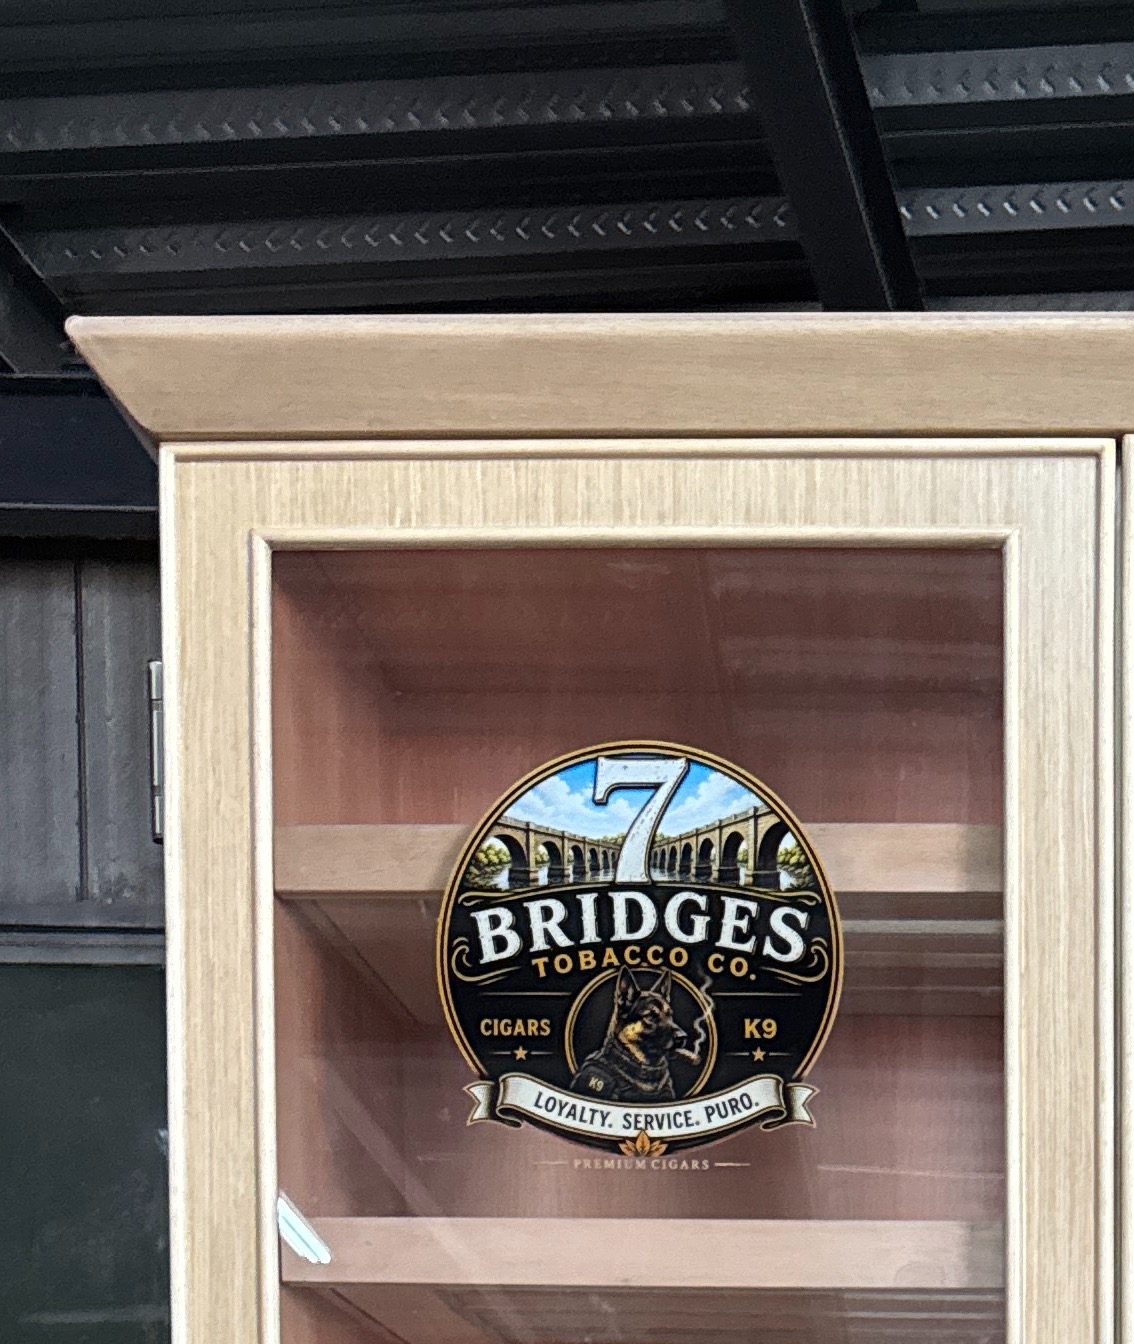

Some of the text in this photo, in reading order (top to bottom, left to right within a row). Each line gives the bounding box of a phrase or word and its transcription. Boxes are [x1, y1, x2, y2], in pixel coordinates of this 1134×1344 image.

[593, 756, 690, 884] 7
[470, 891, 811, 965] BRIDGES
[531, 945, 757, 981] TOBACCO CO.
[480, 1018, 551, 1037] CIGARS
[744, 1018, 778, 1039] K9
[588, 1076, 604, 1092] K9
[533, 1091, 760, 1131] LOYALTY. SERVICE. PURO.
[573, 1159, 710, 1170] PREMIUM CIGARS
